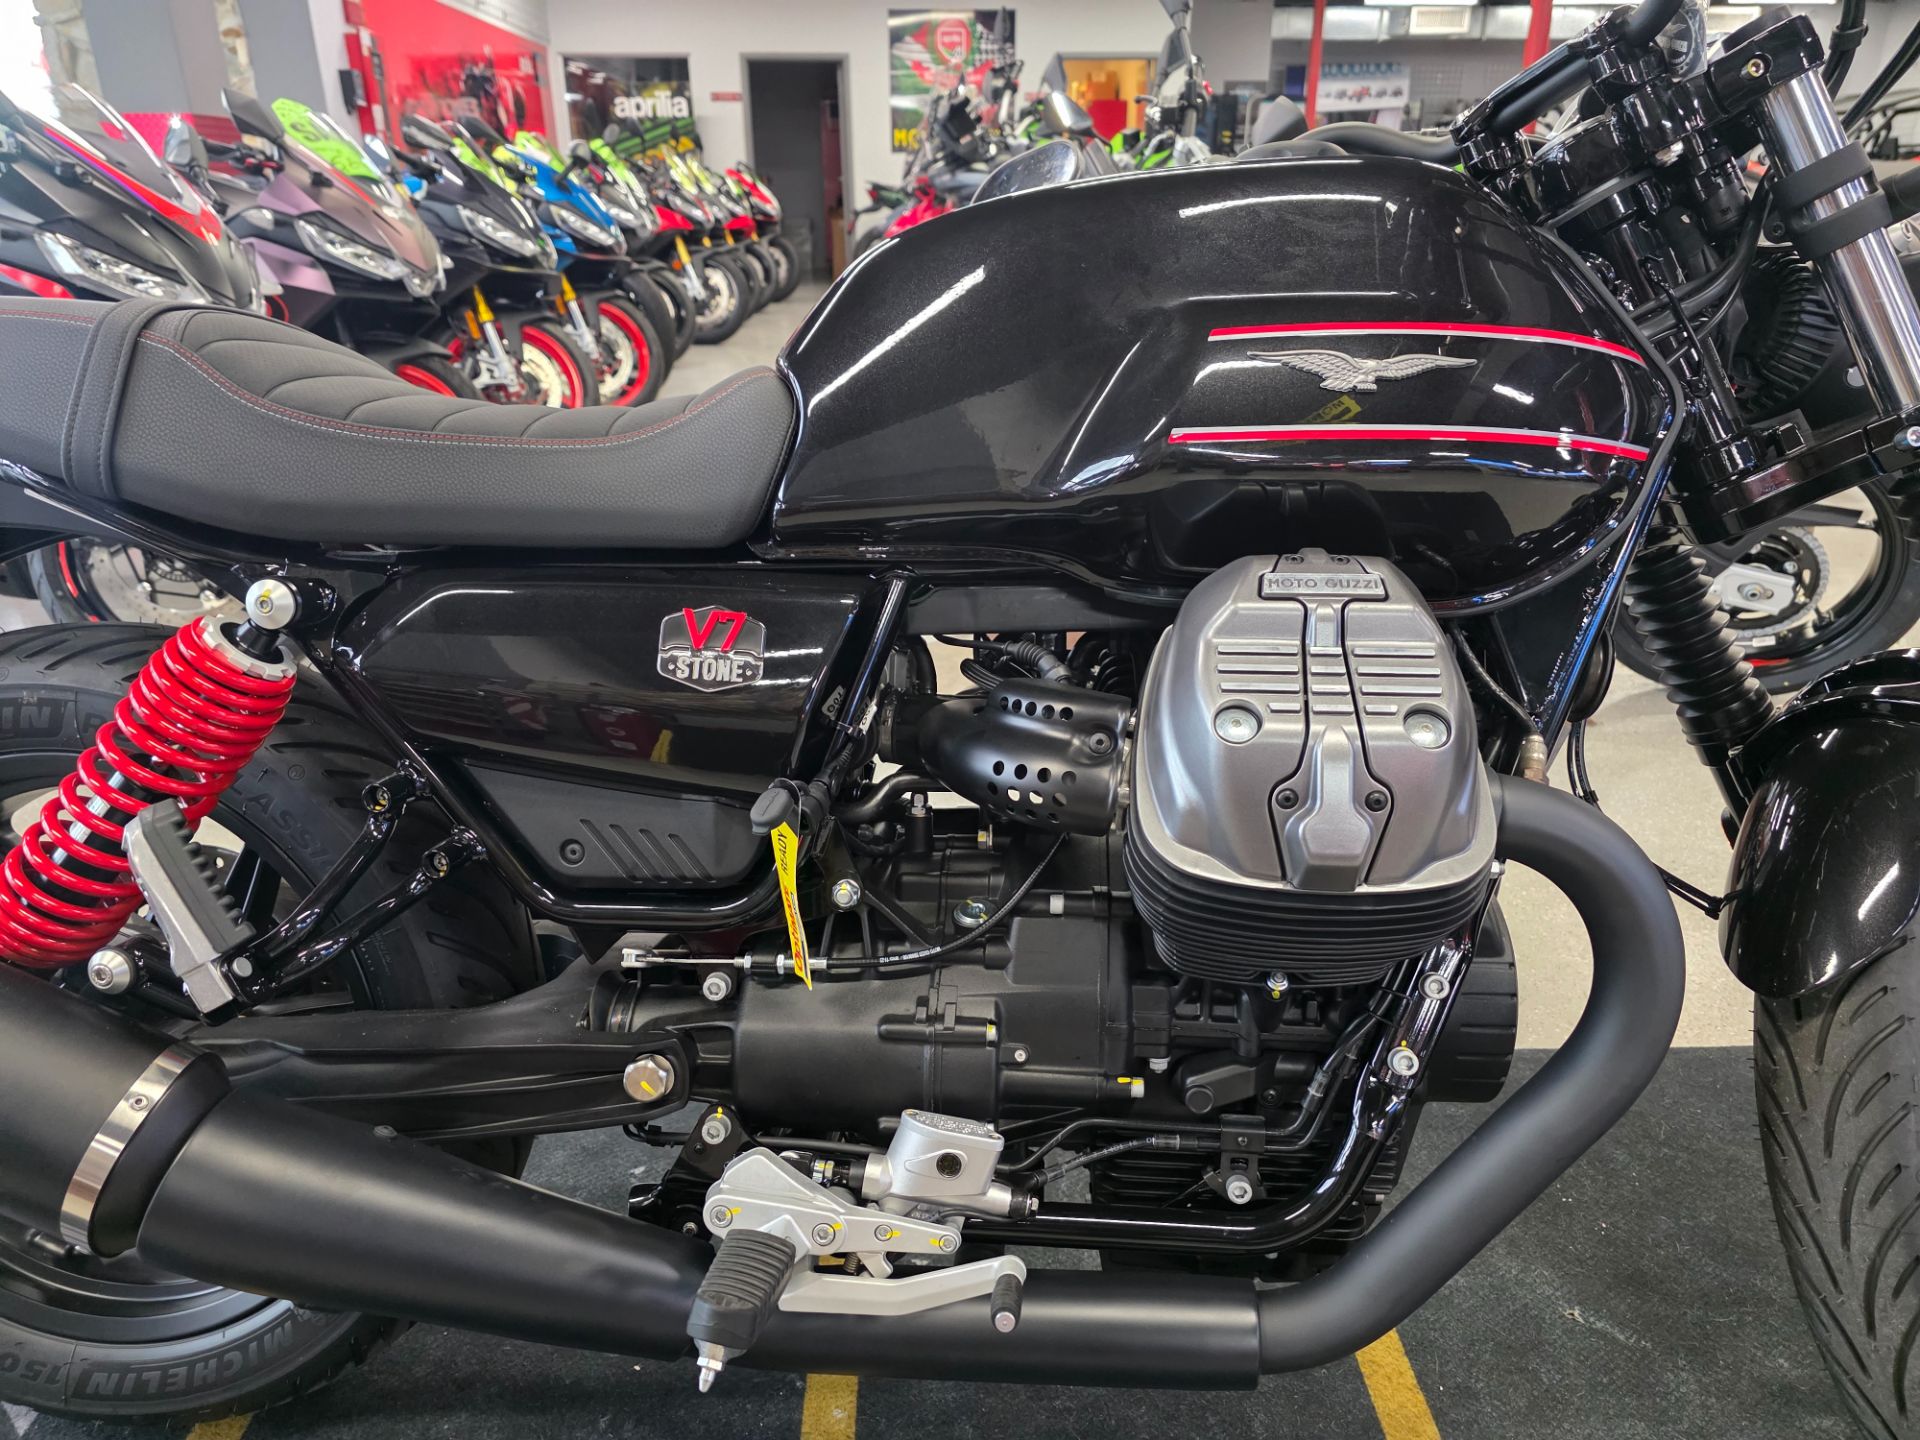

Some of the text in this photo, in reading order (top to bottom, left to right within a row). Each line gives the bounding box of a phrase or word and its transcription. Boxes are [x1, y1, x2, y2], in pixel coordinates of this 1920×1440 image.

[613, 89, 690, 119] aprilia
[1267, 578, 1379, 590] MOTO GUZZI
[682, 608, 747, 652] V7
[675, 656, 745, 683] STONE
[777, 829, 789, 876] READY
[86, 1320, 293, 1395] MICHELIN
